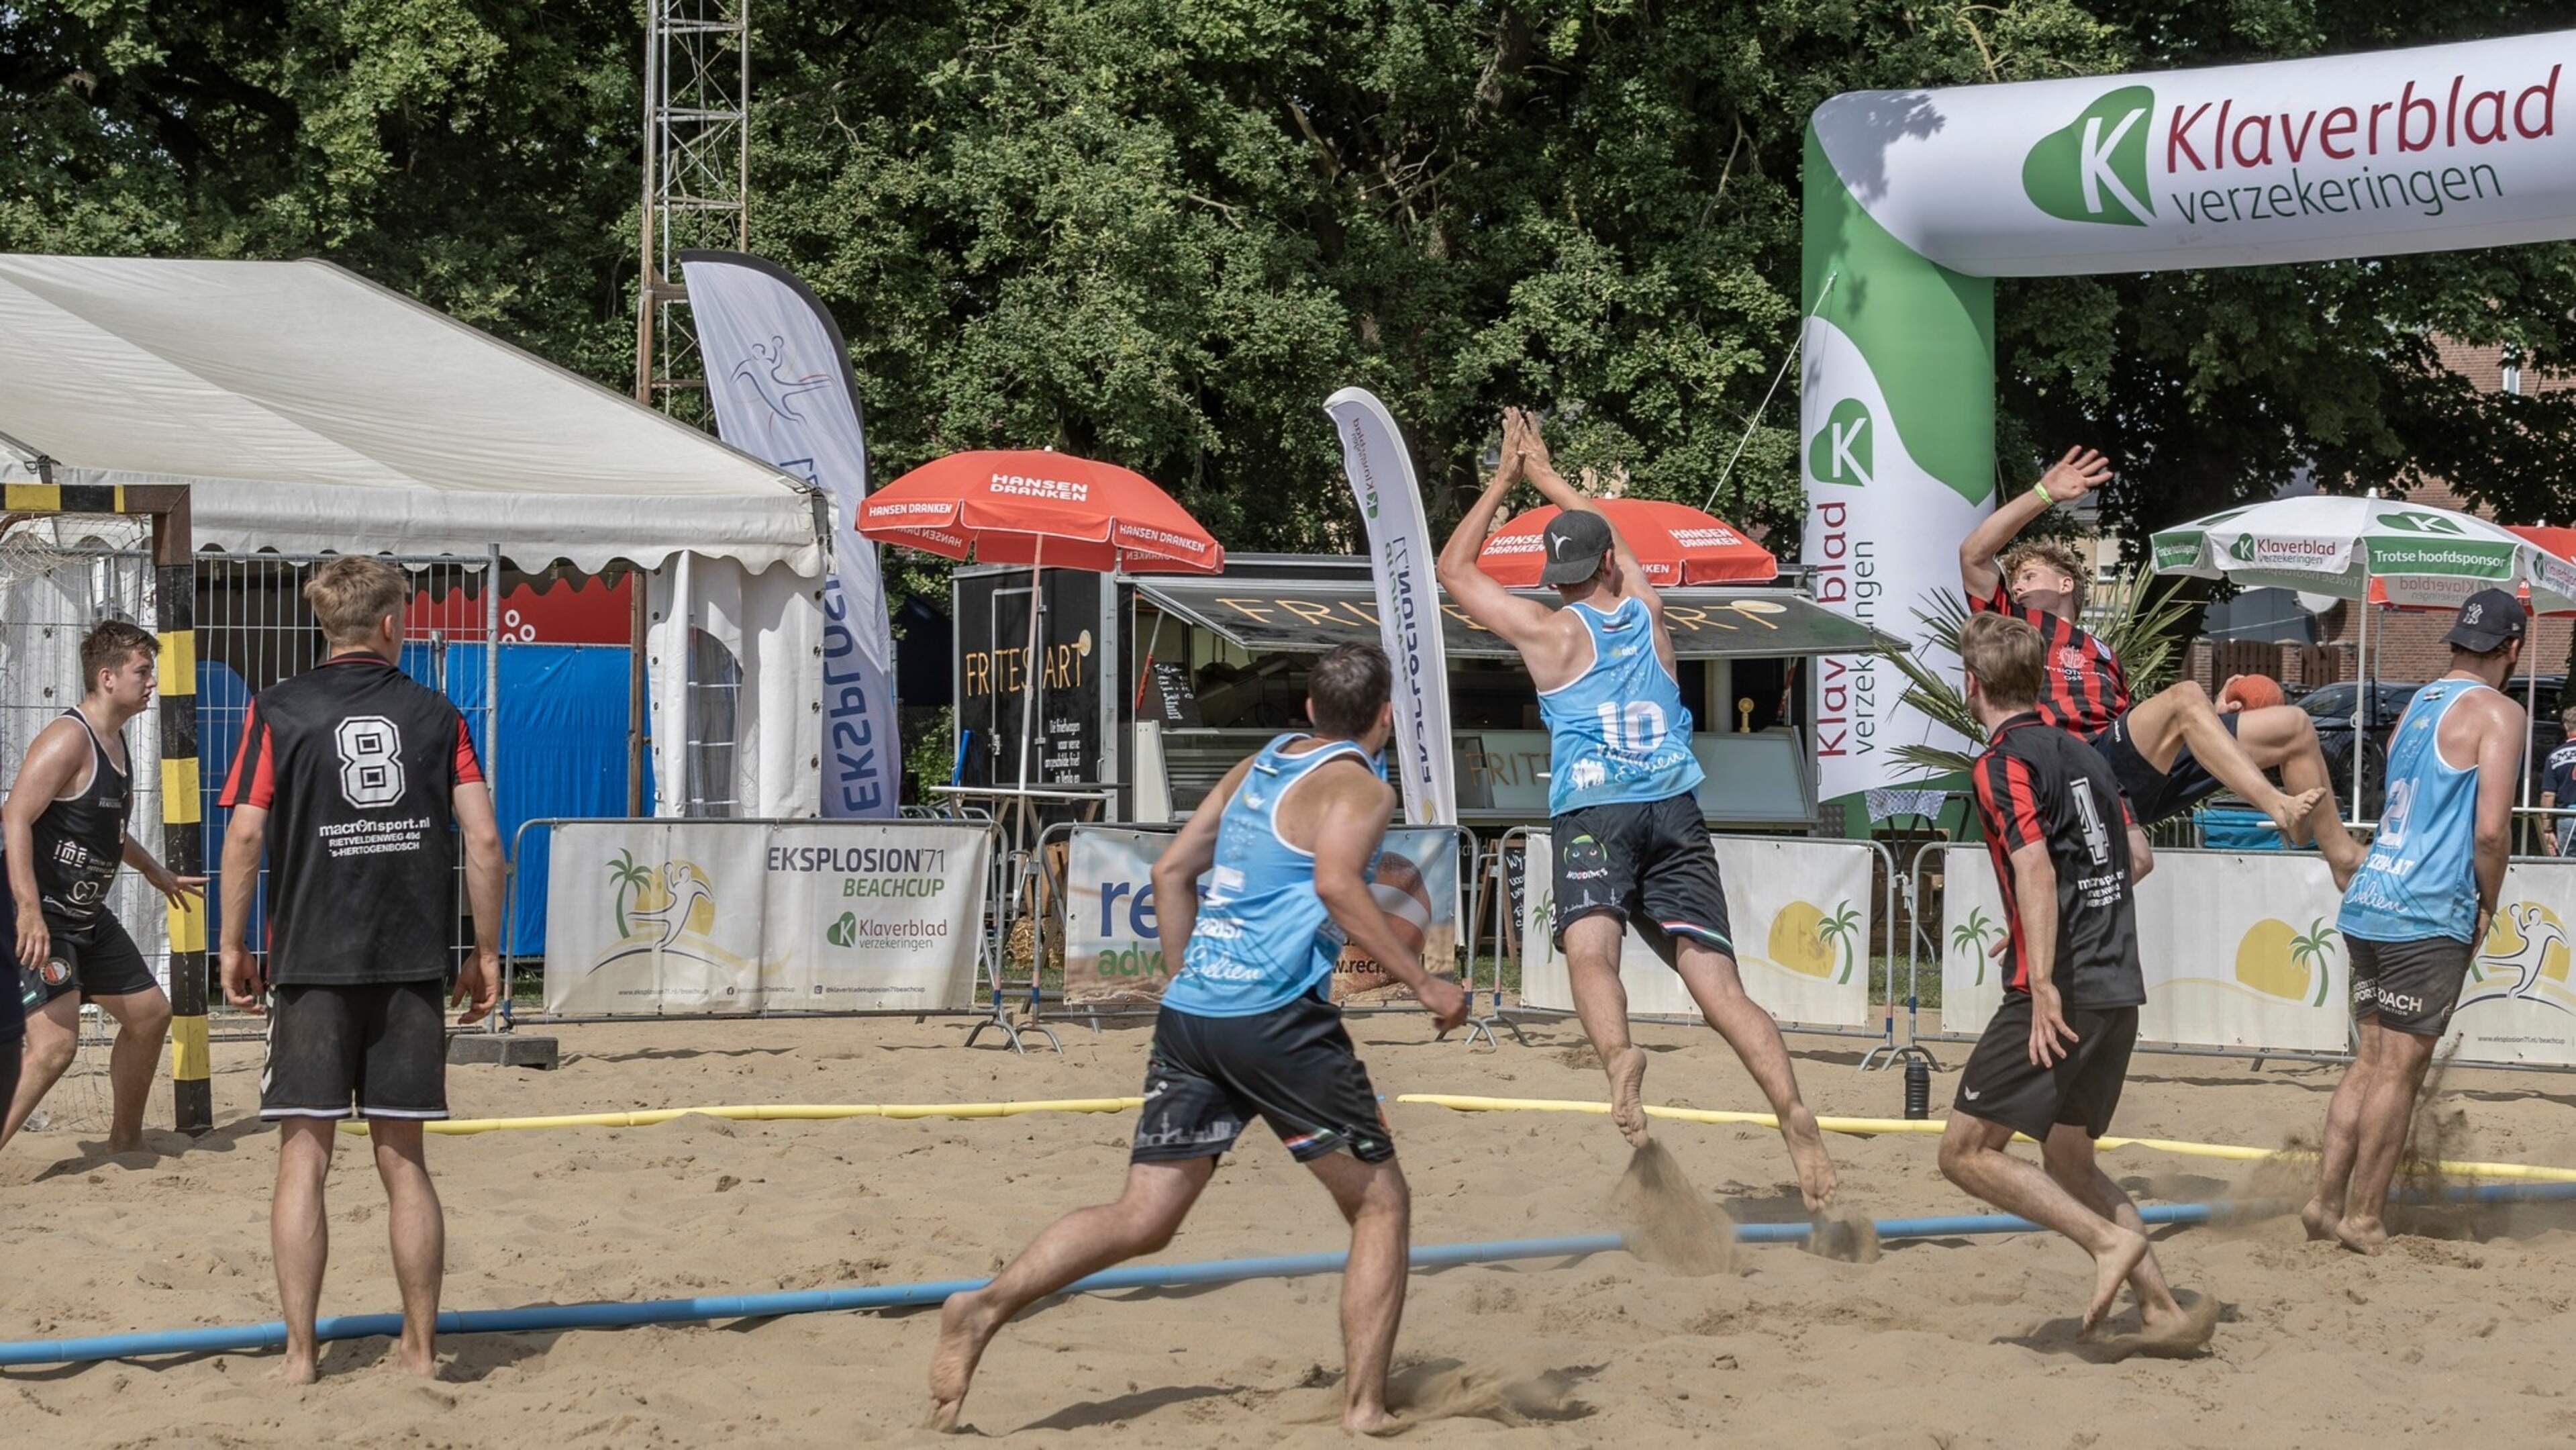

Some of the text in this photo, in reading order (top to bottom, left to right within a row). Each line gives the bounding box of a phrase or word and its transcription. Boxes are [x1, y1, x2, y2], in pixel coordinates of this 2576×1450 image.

[2167, 64, 2562, 174] Klaverblad
[2172, 163, 2504, 224] verzekeringen
[989, 483, 1087, 502] DRANKEN
[991, 473, 1089, 493] HANSEN
[869, 502, 952, 517] HANSEN DRANKEN
[1119, 524, 1205, 553] HANSEN DRANKEN
[1669, 527, 1734, 540] HANSEN
[1679, 536, 1743, 548] DRANKEN
[1482, 544, 1546, 556] DRANKEN
[2257, 538, 2336, 556] Klaverblad
[2258, 553, 2324, 567] verzekeringen
[2374, 548, 2507, 569] Trotse hoofdsponsor
[1816, 501, 1847, 757] Klavblad
[1597, 700, 1669, 753] 10
[334, 715, 406, 810] 8
[318, 816, 430, 837] macronsport.nl
[328, 832, 403, 847] RIETVELDENWEG
[766, 847, 946, 873] EKSPLOSION'71
[842, 877, 946, 898] BEACHCUP
[2344, 873, 2410, 913] Evelien
[858, 918, 948, 938] Klaverblad
[858, 936, 934, 952] verzekeringen
